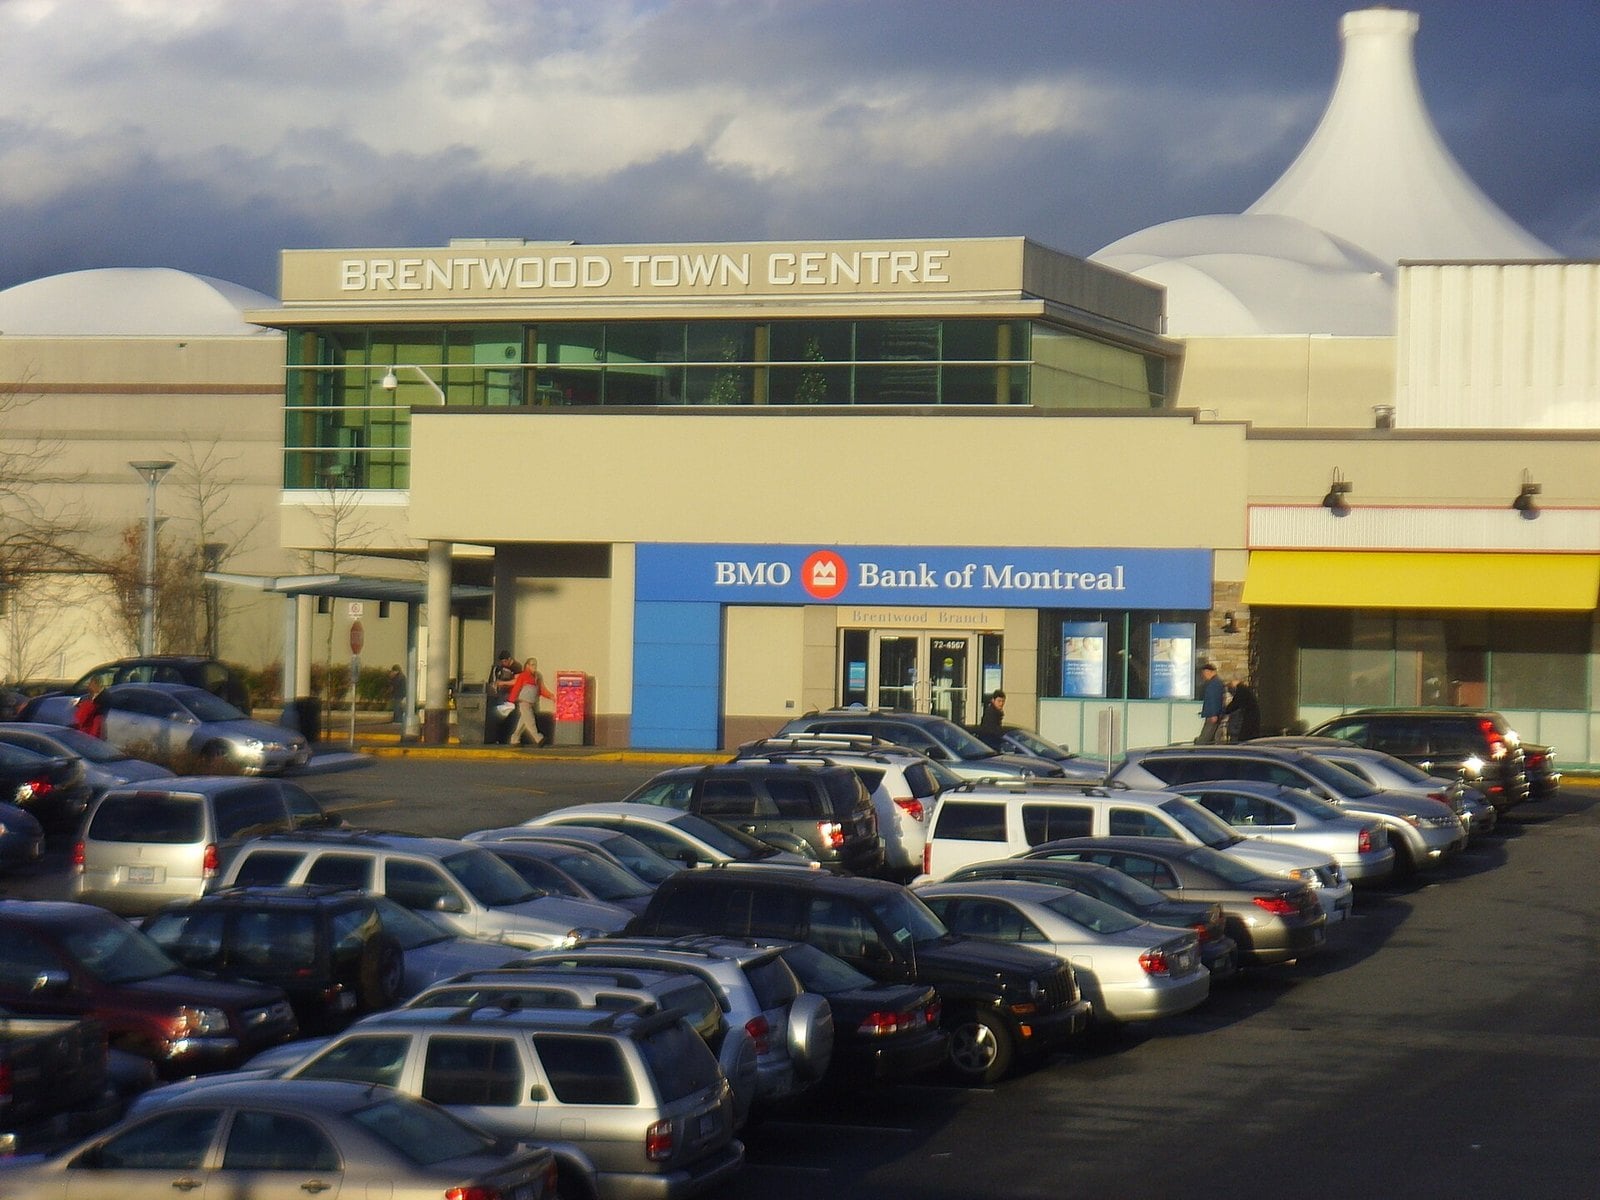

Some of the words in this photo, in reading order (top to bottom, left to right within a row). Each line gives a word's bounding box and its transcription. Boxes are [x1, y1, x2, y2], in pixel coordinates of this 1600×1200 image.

[341, 256, 612, 291] BRENTWOOD
[623, 253, 751, 287] TOWN
[768, 249, 950, 286] CENTRE
[714, 561, 792, 586] BMO
[858, 562, 939, 588] Bank
[944, 563, 978, 588] of
[982, 564, 1126, 591] Montreal
[852, 609, 929, 624] Brentwood
[938, 610, 989, 625] Branch
